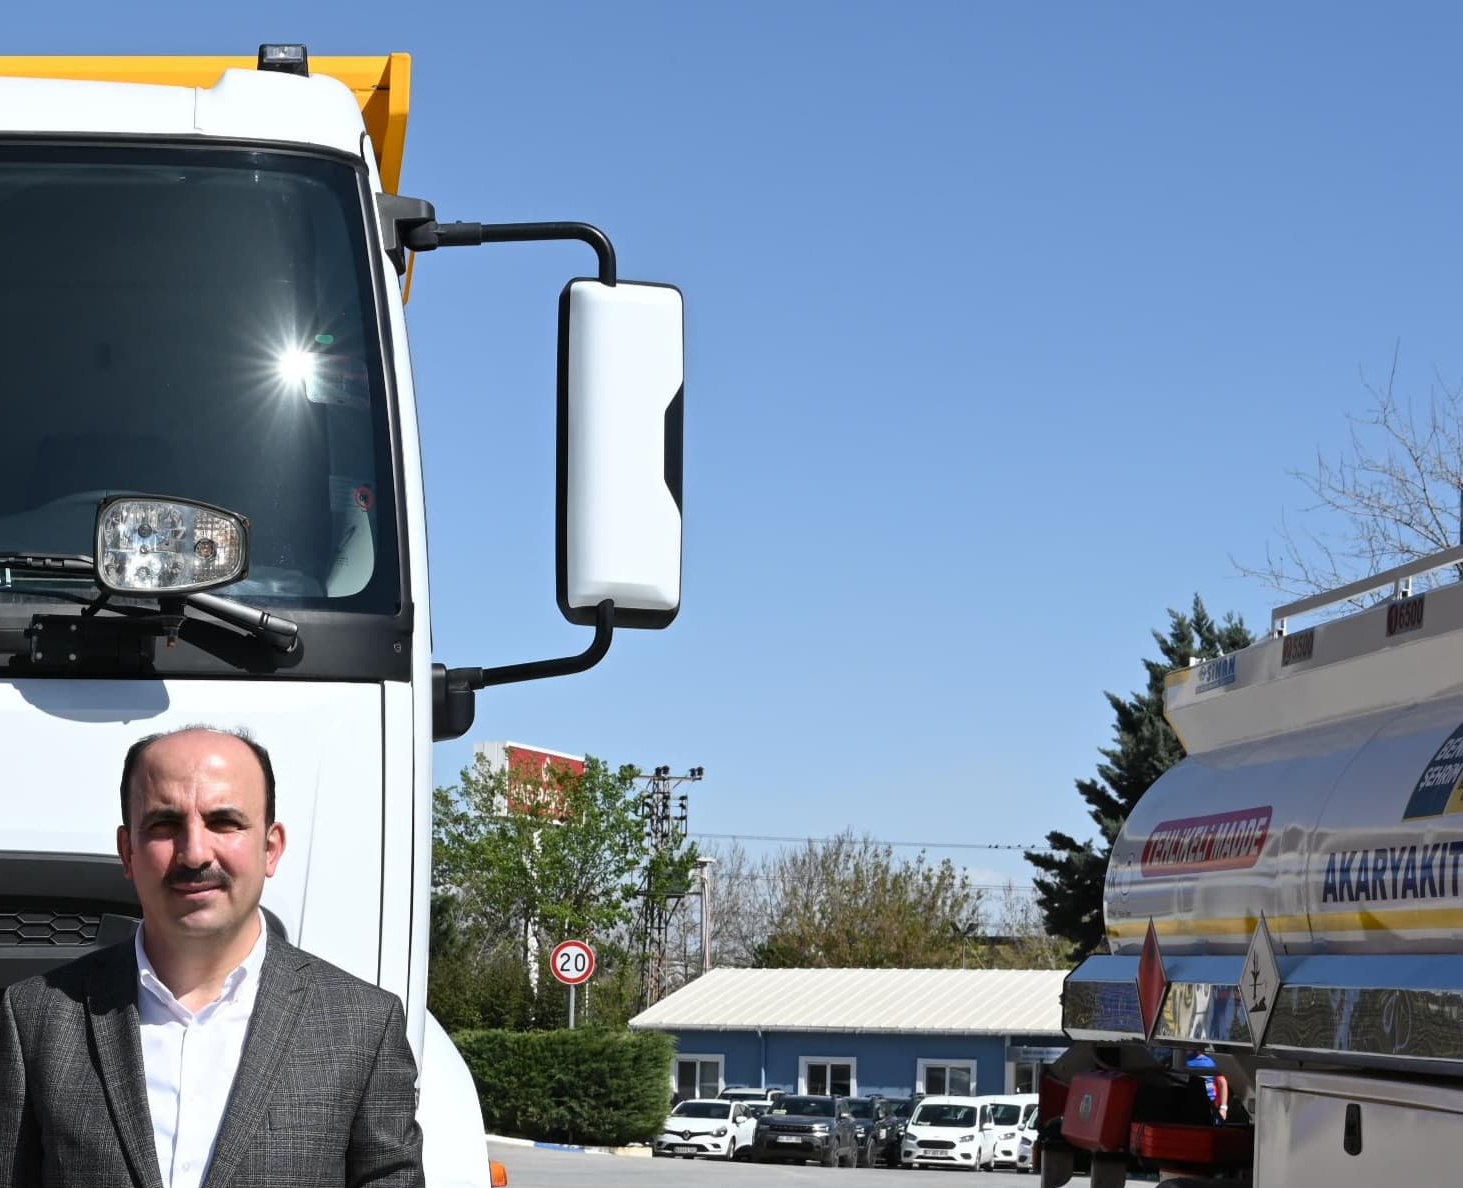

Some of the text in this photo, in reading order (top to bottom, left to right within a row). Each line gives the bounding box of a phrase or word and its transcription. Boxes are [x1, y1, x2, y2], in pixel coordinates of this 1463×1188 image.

[1209, 817, 1269, 861] MADDE
[1322, 841, 1463, 903] AKARYAKIT
[560, 952, 586, 972] 20
